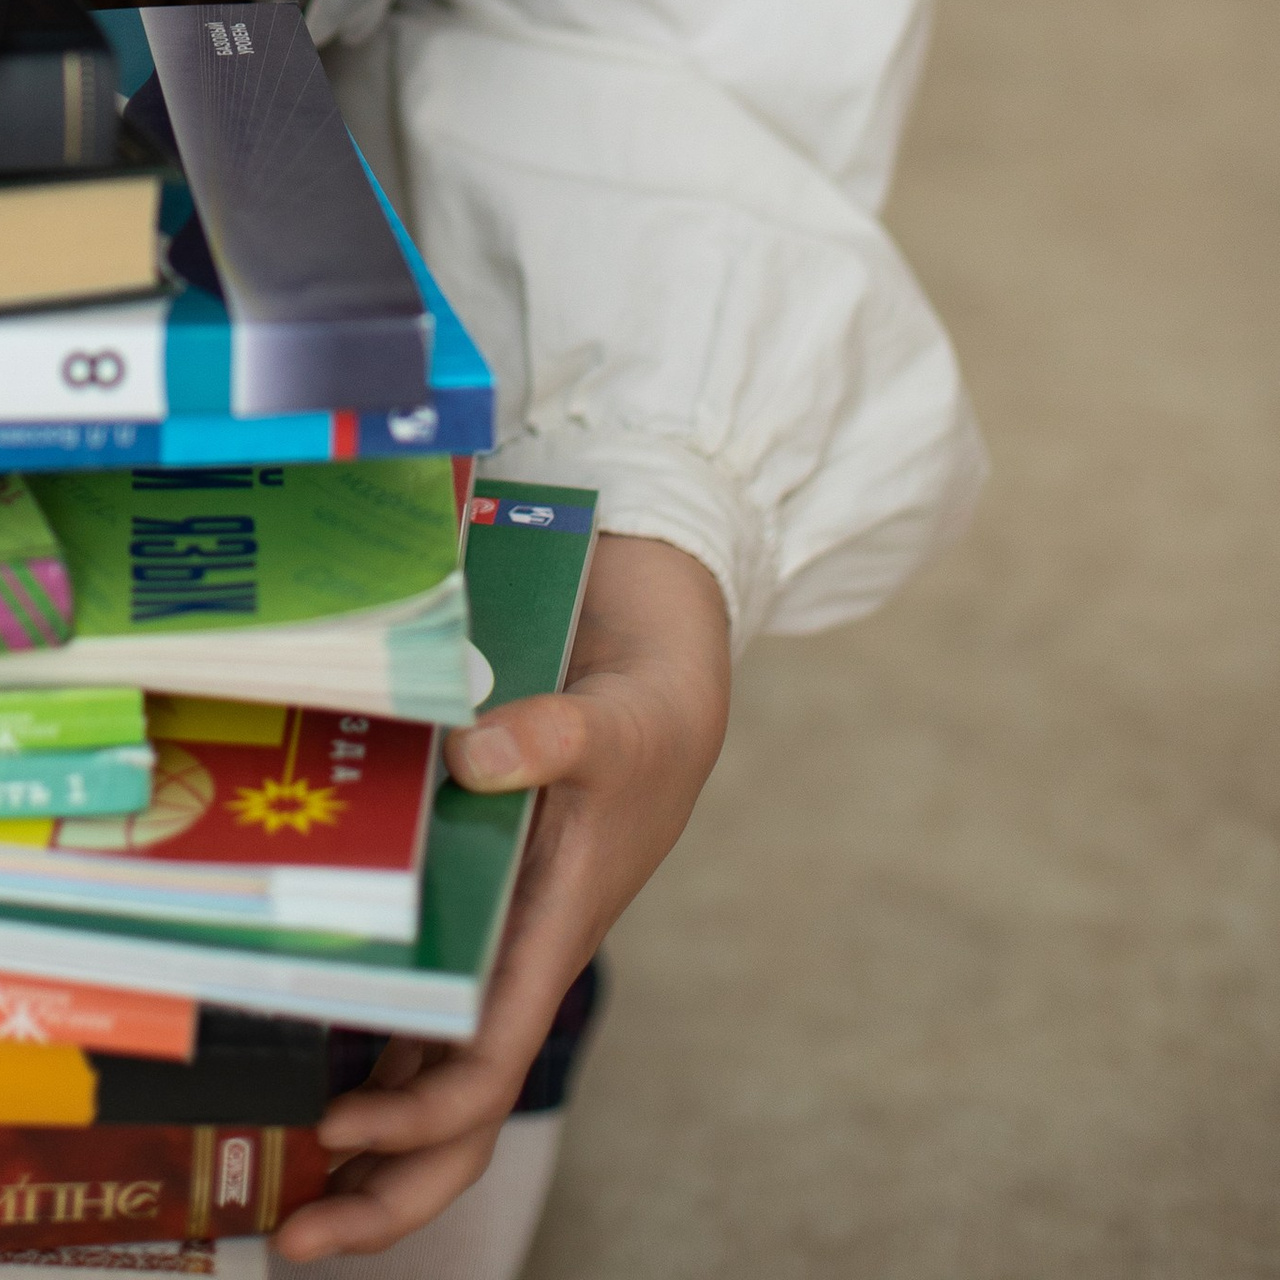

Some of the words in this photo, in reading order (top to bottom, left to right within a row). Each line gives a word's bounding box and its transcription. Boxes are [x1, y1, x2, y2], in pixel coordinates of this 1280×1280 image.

[204, 21, 233, 56] БАЗОВЫЙ
[231, 23, 254, 54] УРОВЕНЬ
[61, 348, 126, 392] 8
[129, 514, 258, 622] ЯЗЫК
[66, 771, 87, 807] 1
